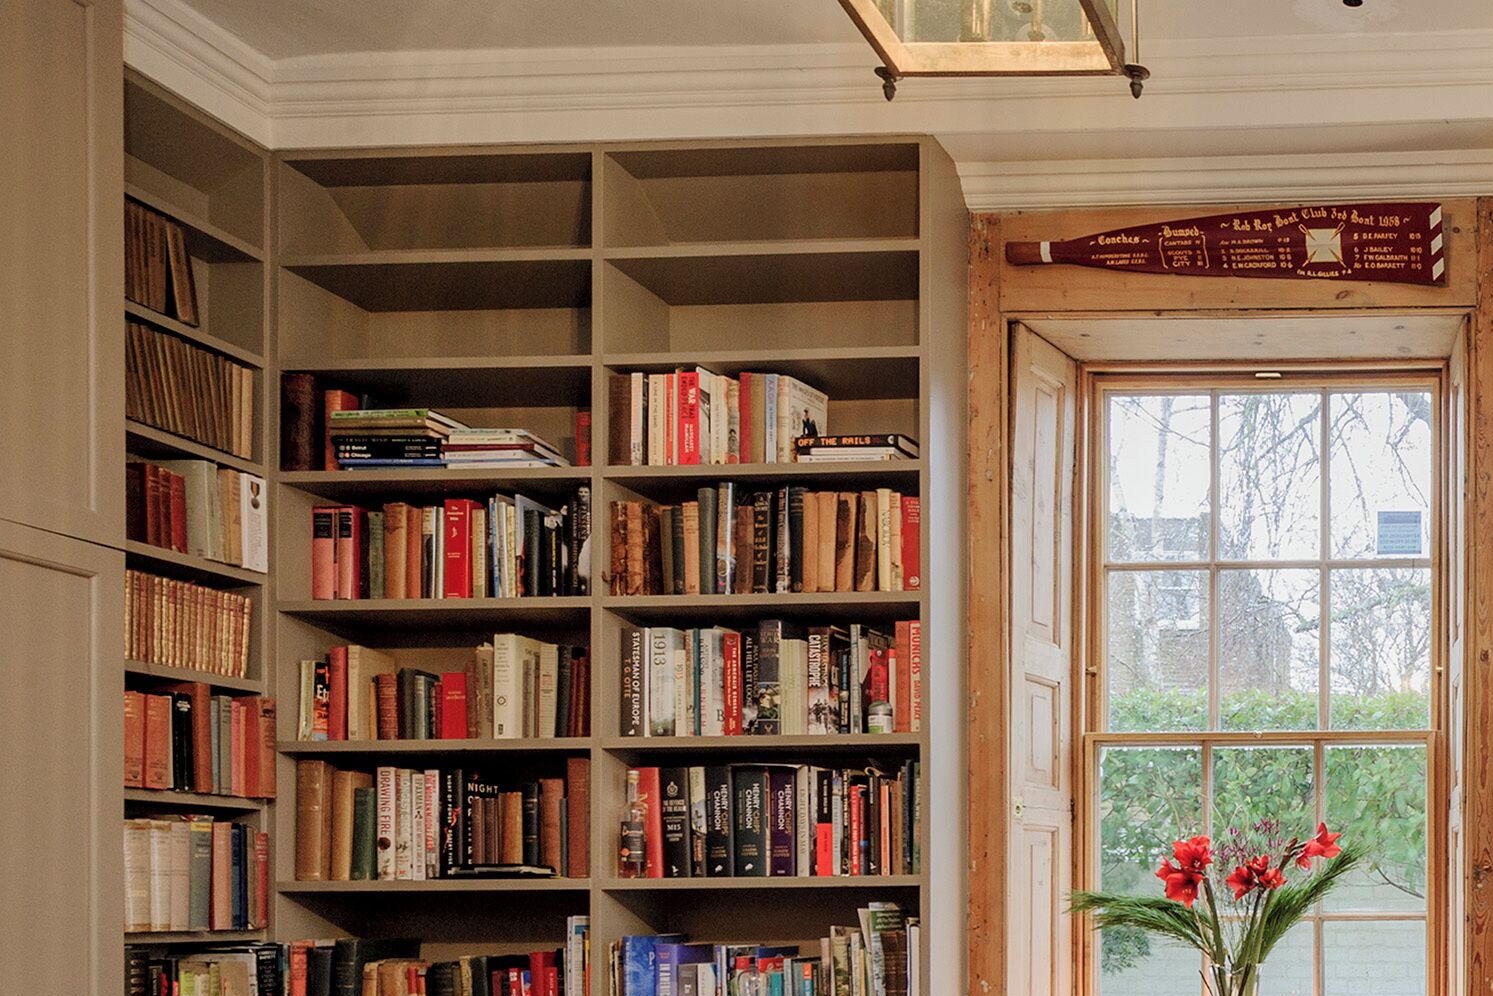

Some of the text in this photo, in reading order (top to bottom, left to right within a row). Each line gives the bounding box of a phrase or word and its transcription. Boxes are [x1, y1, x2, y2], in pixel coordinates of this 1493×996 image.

[1233, 219, 1250, 232] Rob
[1253, 219, 1272, 232] Roy
[1302, 208, 1327, 220] Club
[688, 388, 696, 404] WAR
[798, 436, 870, 446] OFF THE RAILS
[632, 632, 640, 679] STATESMAN
[654, 634, 666, 665] 1913
[808, 634, 820, 687] CATASTROPHE
[912, 627, 920, 674] MUNICHS
[632, 680, 639, 692] OF
[468, 783, 498, 793] NIGHT
[381, 771, 392, 834] DRAWING FIRE
